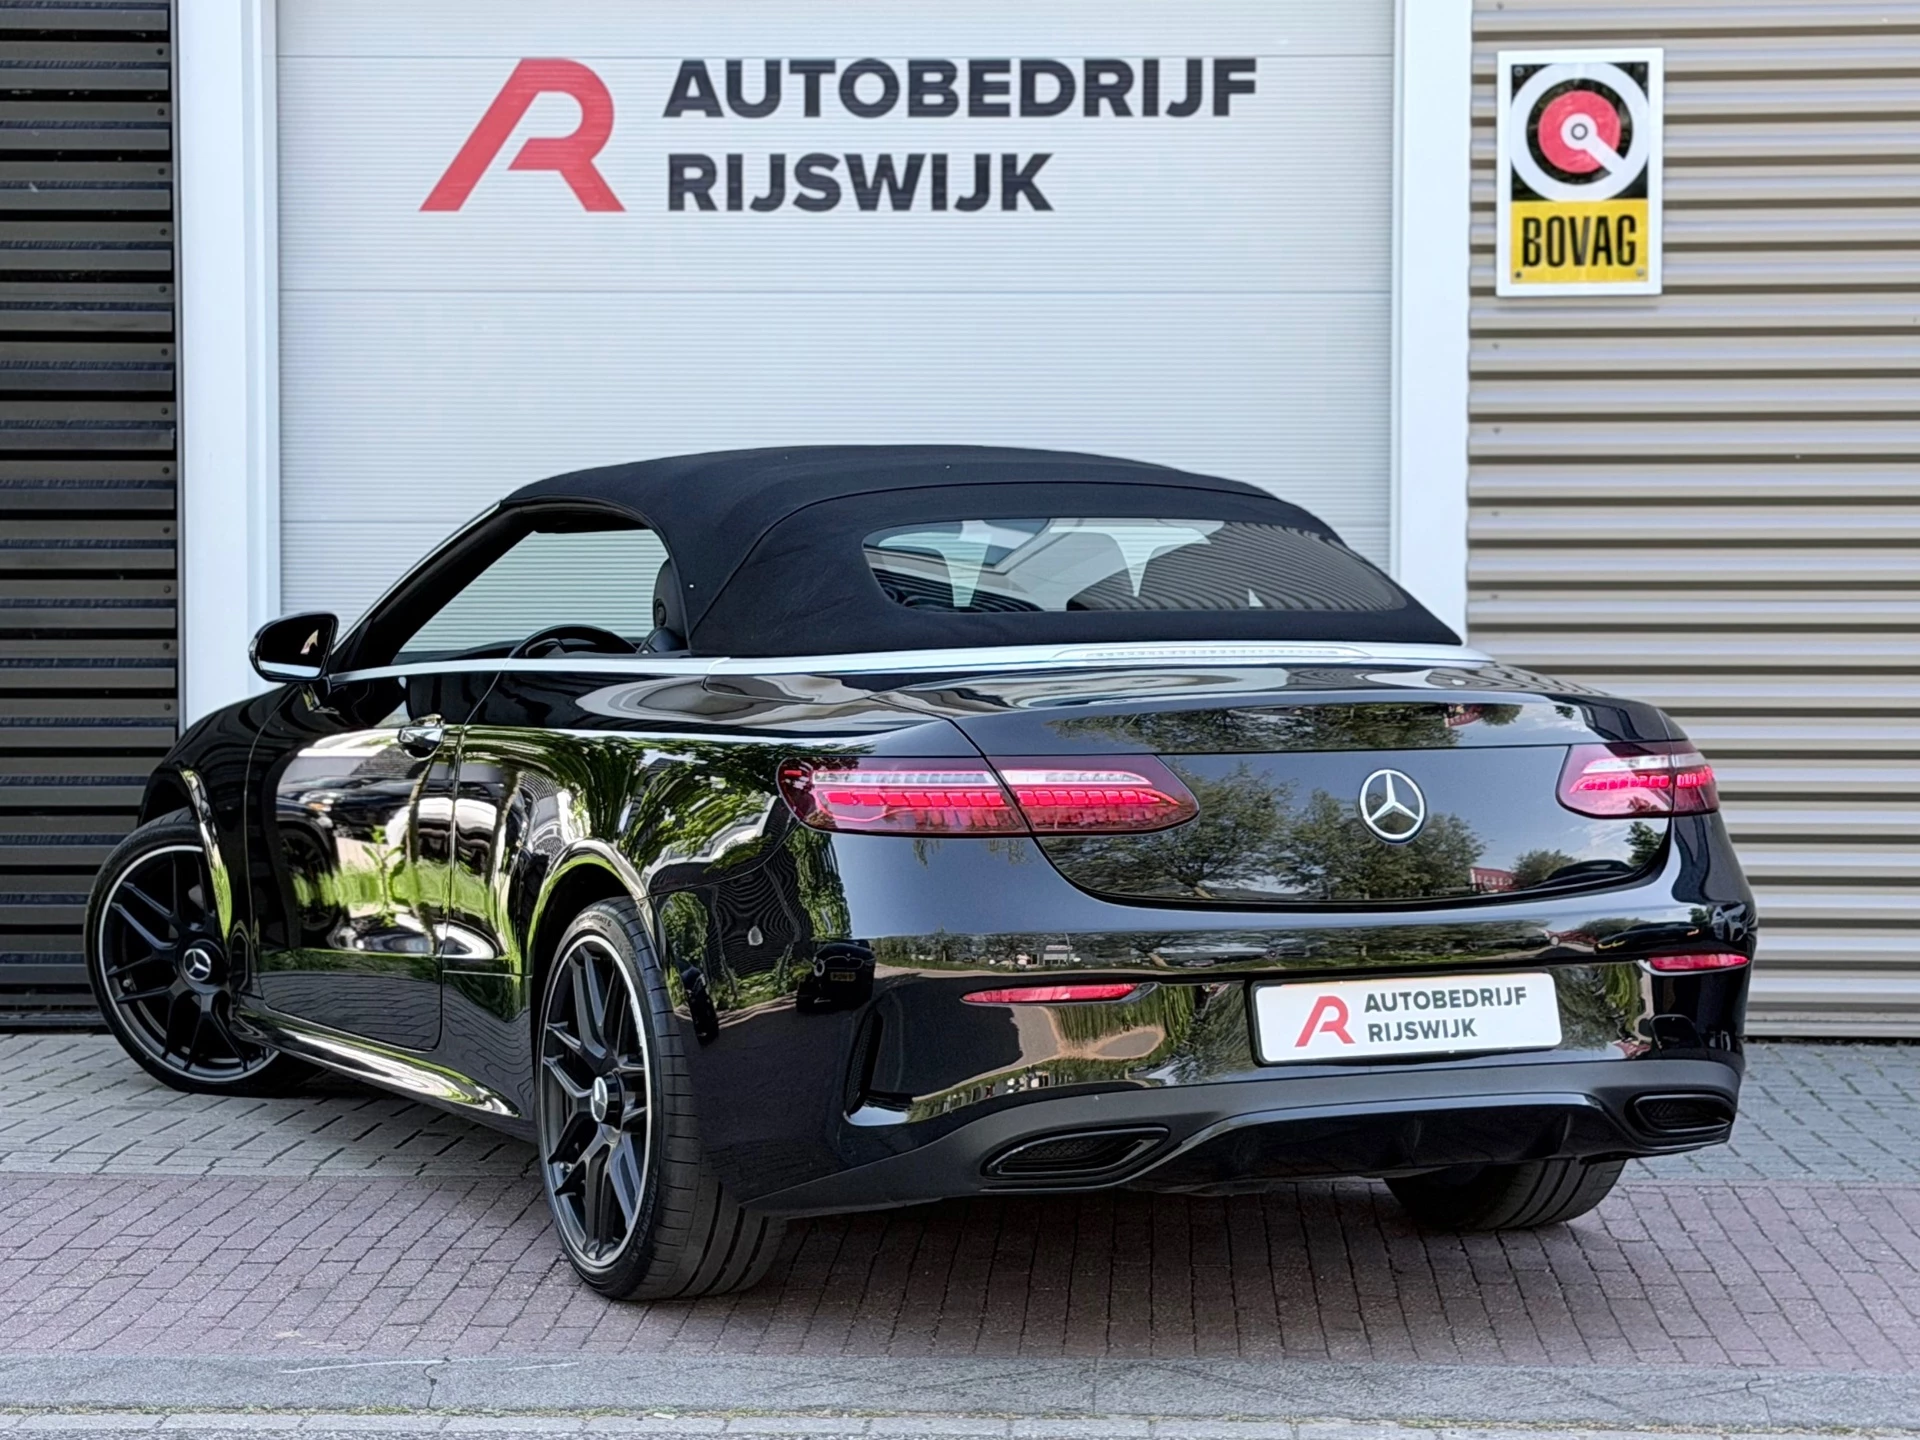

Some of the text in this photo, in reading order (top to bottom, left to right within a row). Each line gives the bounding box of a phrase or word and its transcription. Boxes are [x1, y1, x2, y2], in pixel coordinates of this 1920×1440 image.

[663, 58, 1257, 118] AUTOBEDRIJF
[667, 153, 1054, 212] RIJSWIJK
[1522, 214, 1637, 268] BOVAG
[1364, 986, 1527, 1013] AUTOBEDRIJF
[1367, 1018, 1478, 1043] RIJSWIJK
